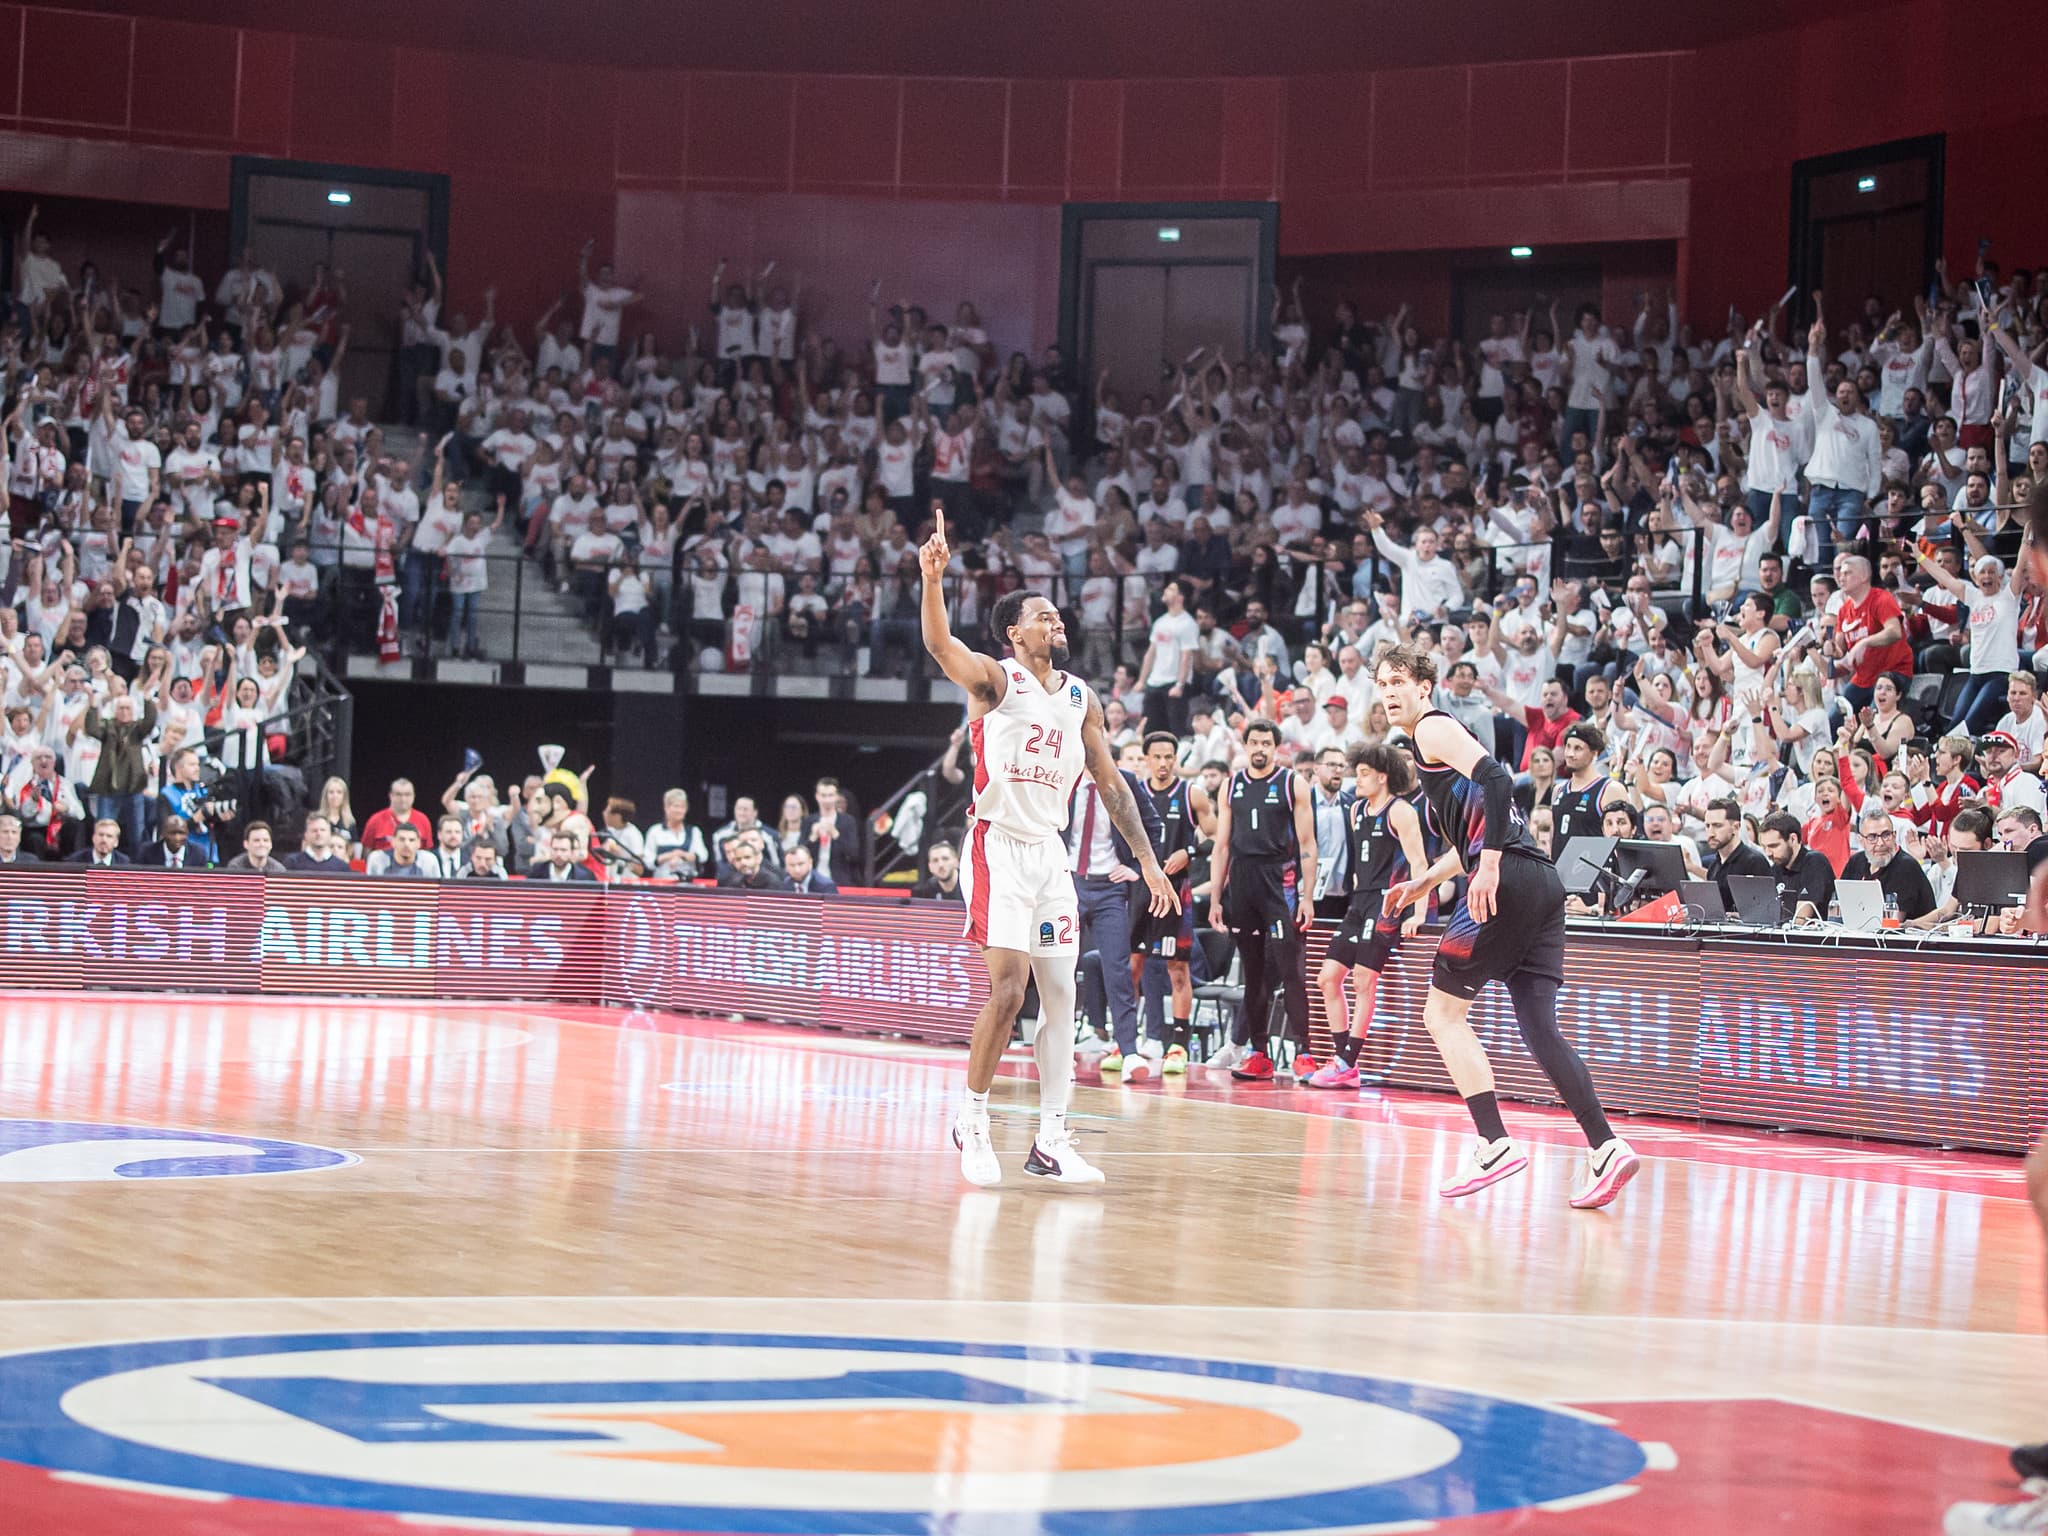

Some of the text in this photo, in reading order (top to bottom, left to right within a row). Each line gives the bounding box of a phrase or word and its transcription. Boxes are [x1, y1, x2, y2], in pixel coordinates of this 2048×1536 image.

[1025, 723, 1063, 759] 24
[1251, 808, 1258, 830] 1
[1560, 814, 1571, 835] 6
[1360, 840, 1370, 862] 2
[5, 899, 563, 971] RKISH AIRLINES
[1361, 918, 1375, 940] 2
[1161, 936, 1176, 957] 10
[673, 922, 972, 1009] TURKISH AIRLINES
[1690, 994, 1986, 1097] AIRLINES
